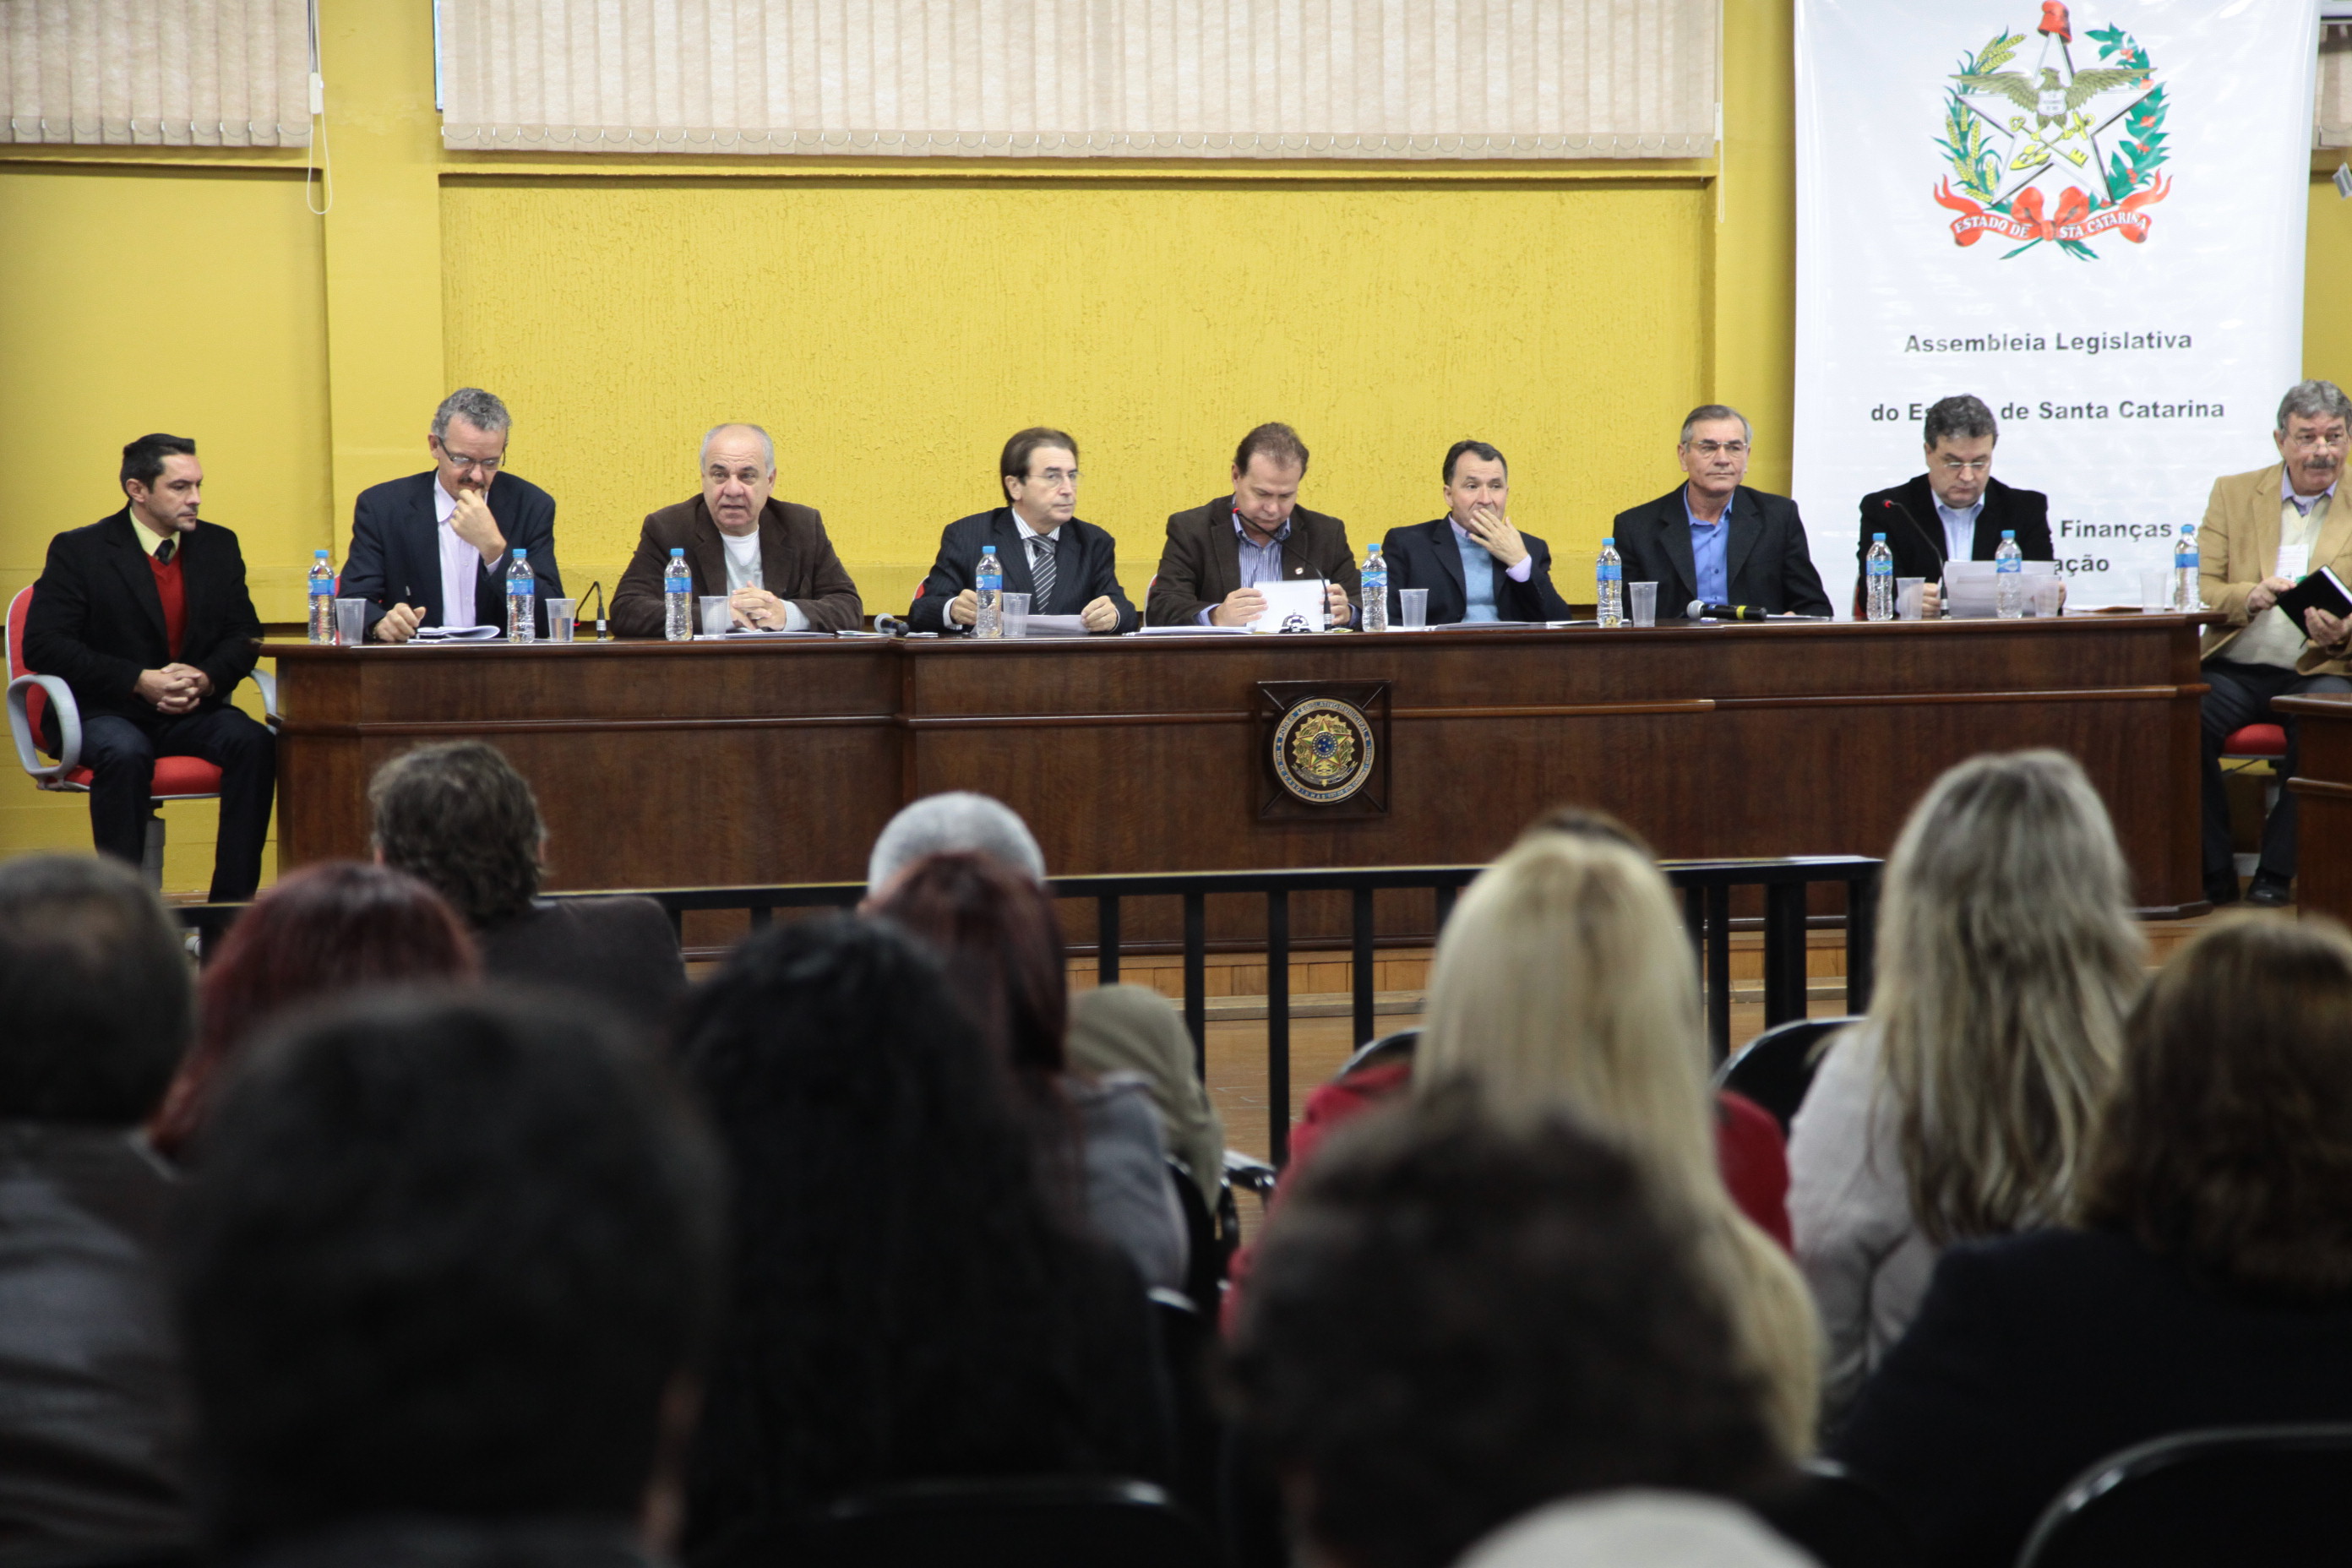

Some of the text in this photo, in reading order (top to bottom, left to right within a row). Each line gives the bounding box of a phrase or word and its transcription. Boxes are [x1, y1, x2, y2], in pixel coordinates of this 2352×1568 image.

[1955, 215, 2008, 234] ESTADO
[2009, 225, 2028, 237] DE
[2087, 212, 2147, 231] CATARINA
[1904, 331, 2192, 355] Assembleia Legislativa
[1870, 404, 1899, 421] do
[2001, 402, 2029, 420] de
[2039, 401, 2109, 419] Santa
[2118, 400, 2224, 418] Catarina
[2061, 520, 2172, 542] Finanças
